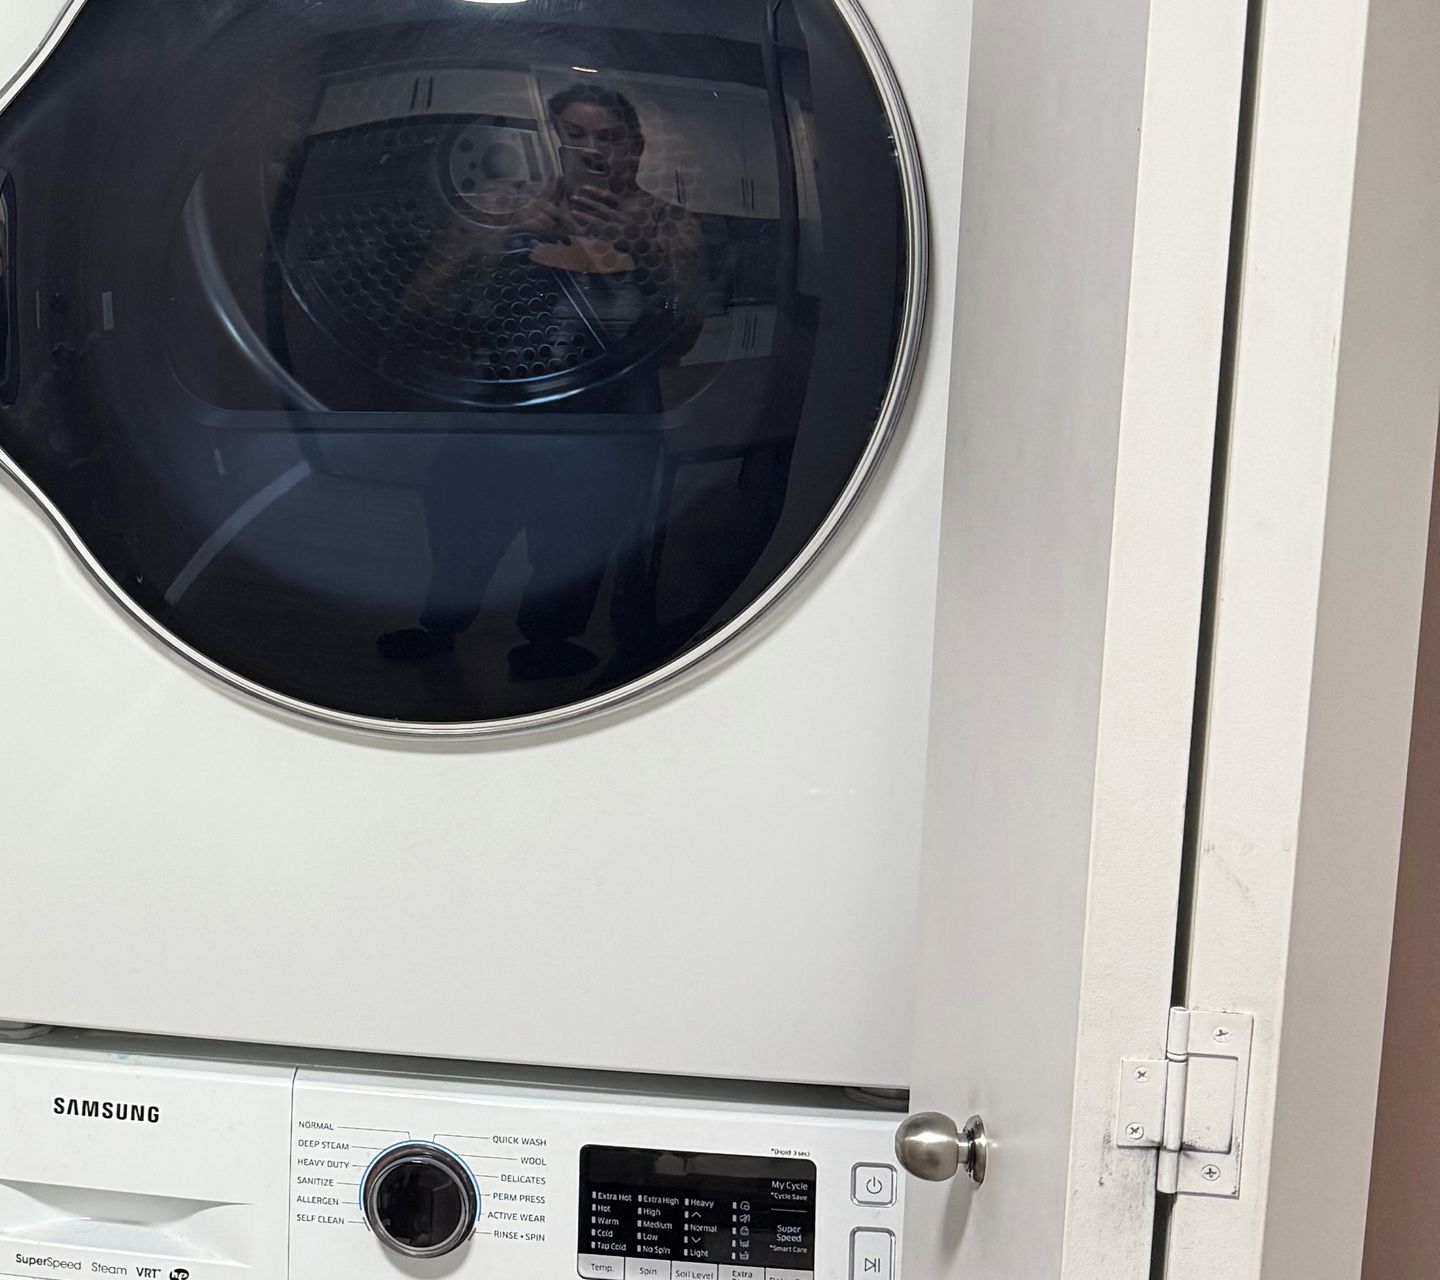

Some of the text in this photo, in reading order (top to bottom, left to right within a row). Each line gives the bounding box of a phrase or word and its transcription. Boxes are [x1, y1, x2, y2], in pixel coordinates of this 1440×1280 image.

[53, 1097, 160, 1123] SAMSUNG
[298, 1121, 334, 1130] NORMAL
[298, 1139, 350, 1150] DEEP STEAM
[492, 1135, 547, 1146] QUICK WASH
[297, 1158, 350, 1169] HEAVY DUTY
[520, 1157, 547, 1166] WOOL
[297, 1176, 334, 1187] SANITIZE
[500, 1174, 546, 1185] DELICATES
[771, 1181, 808, 1191] My Cycle
[296, 1195, 339, 1206] ALLERGEN
[493, 1192, 546, 1204] PERM PRESS
[598, 1192, 632, 1202] Extra Hot
[643, 1196, 679, 1206] Extra High
[597, 1204, 611, 1213] Hot
[690, 1199, 715, 1209] Heavy
[487, 1211, 546, 1223] ACTIVE WEAR
[643, 1208, 661, 1217] High
[296, 1213, 345, 1225] SELF CLEAN
[597, 1217, 619, 1225] Warm
[643, 1221, 673, 1230] Medium
[690, 1224, 717, 1233] Normal
[777, 1225, 801, 1234] Super
[493, 1230, 545, 1242] RINSE SPIN
[597, 1229, 614, 1238] Cold
[642, 1233, 658, 1241] Low
[776, 1233, 802, 1243] Speed
[597, 1242, 627, 1251] Tap Cold
[654, 1246, 671, 1255] Spin
[792, 1246, 808, 1254] Care
[690, 1249, 709, 1258] Light
[15, 1253, 82, 1271] SuperSpeed
[91, 1262, 128, 1275] Steam
[639, 1267, 657, 1276] Spin
[675, 1270, 714, 1280] Soil Level
[732, 1270, 753, 1279] Extra
